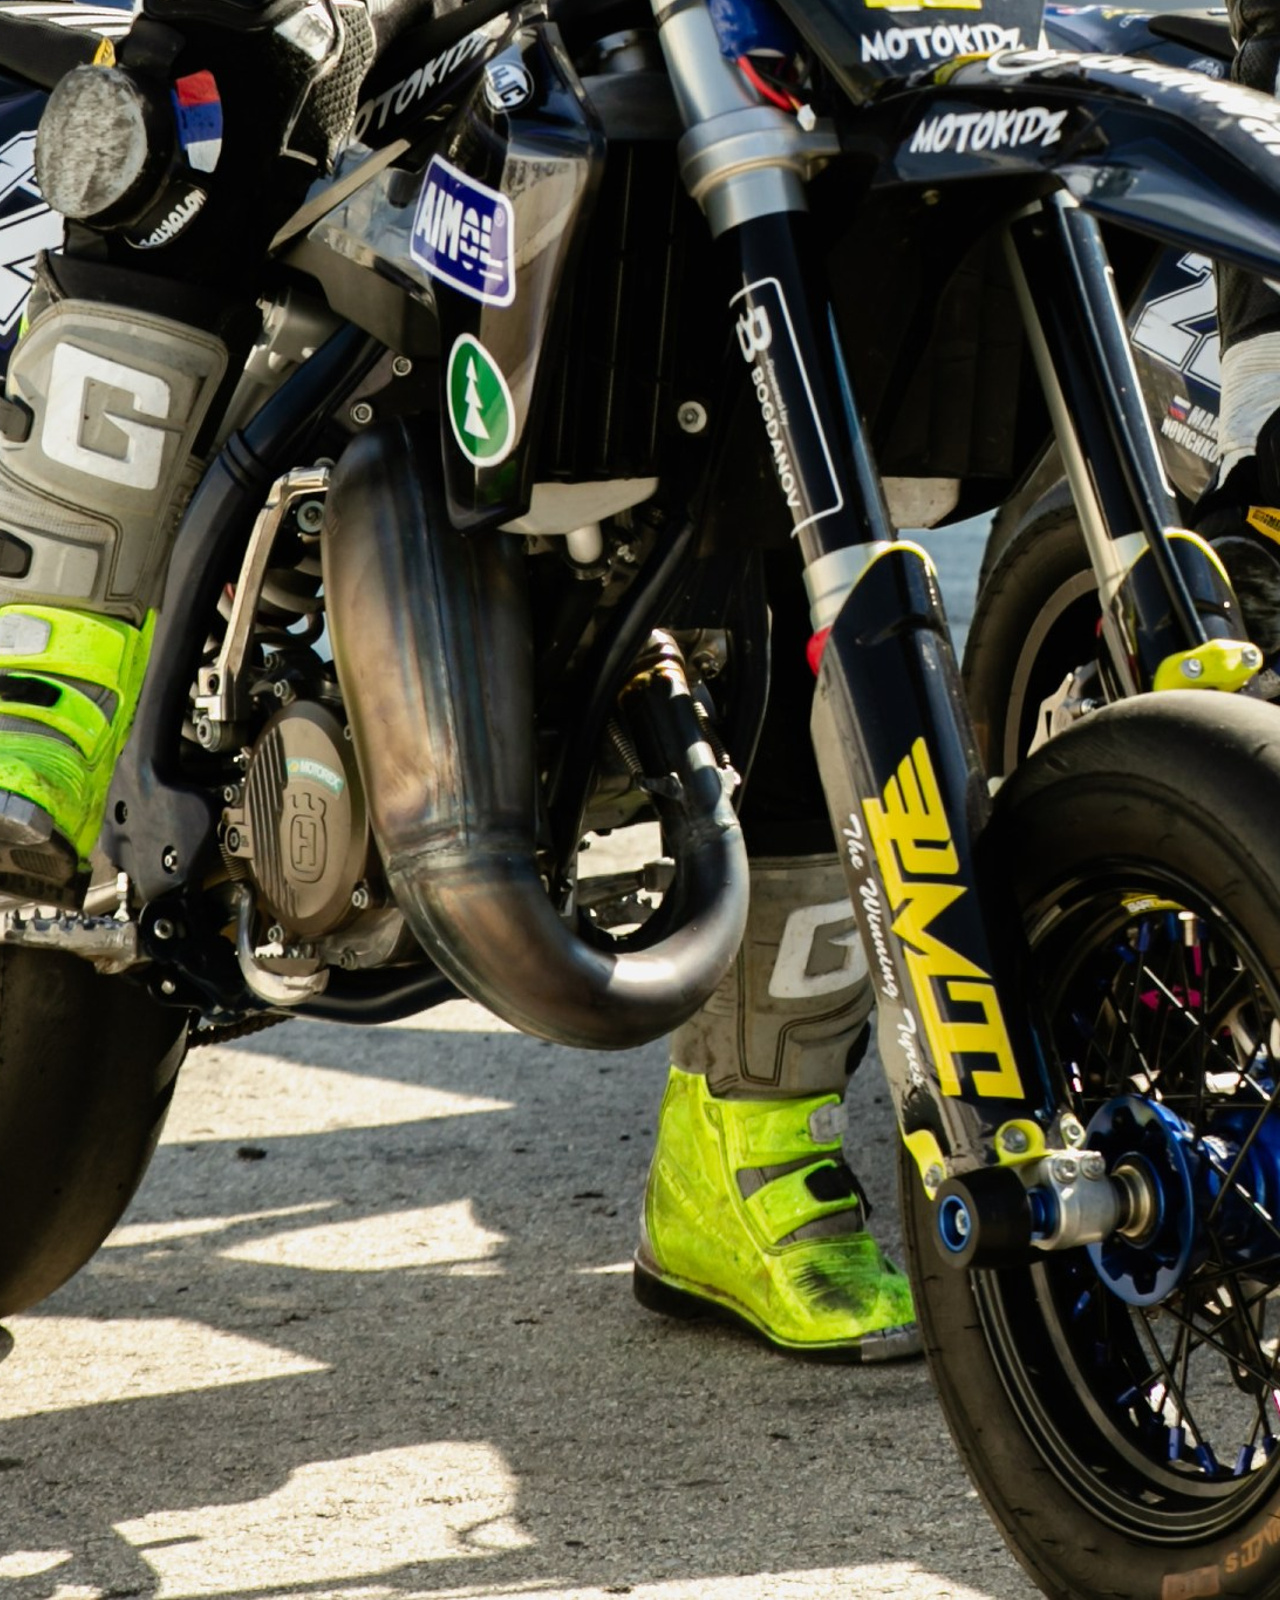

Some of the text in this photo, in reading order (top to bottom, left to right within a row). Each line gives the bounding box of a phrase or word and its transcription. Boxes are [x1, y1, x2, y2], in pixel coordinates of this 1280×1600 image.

[860, 22, 1026, 63] MOTOKIDZ
[910, 107, 1067, 154] MOTOKIDZ
[416, 181, 504, 282] AIMOL
[42, 342, 171, 491] G
[751, 365, 801, 507] BOGDANOV
[843, 813, 863, 869] The
[859, 877, 899, 999] Winning
[862, 736, 1026, 1100] DMT
